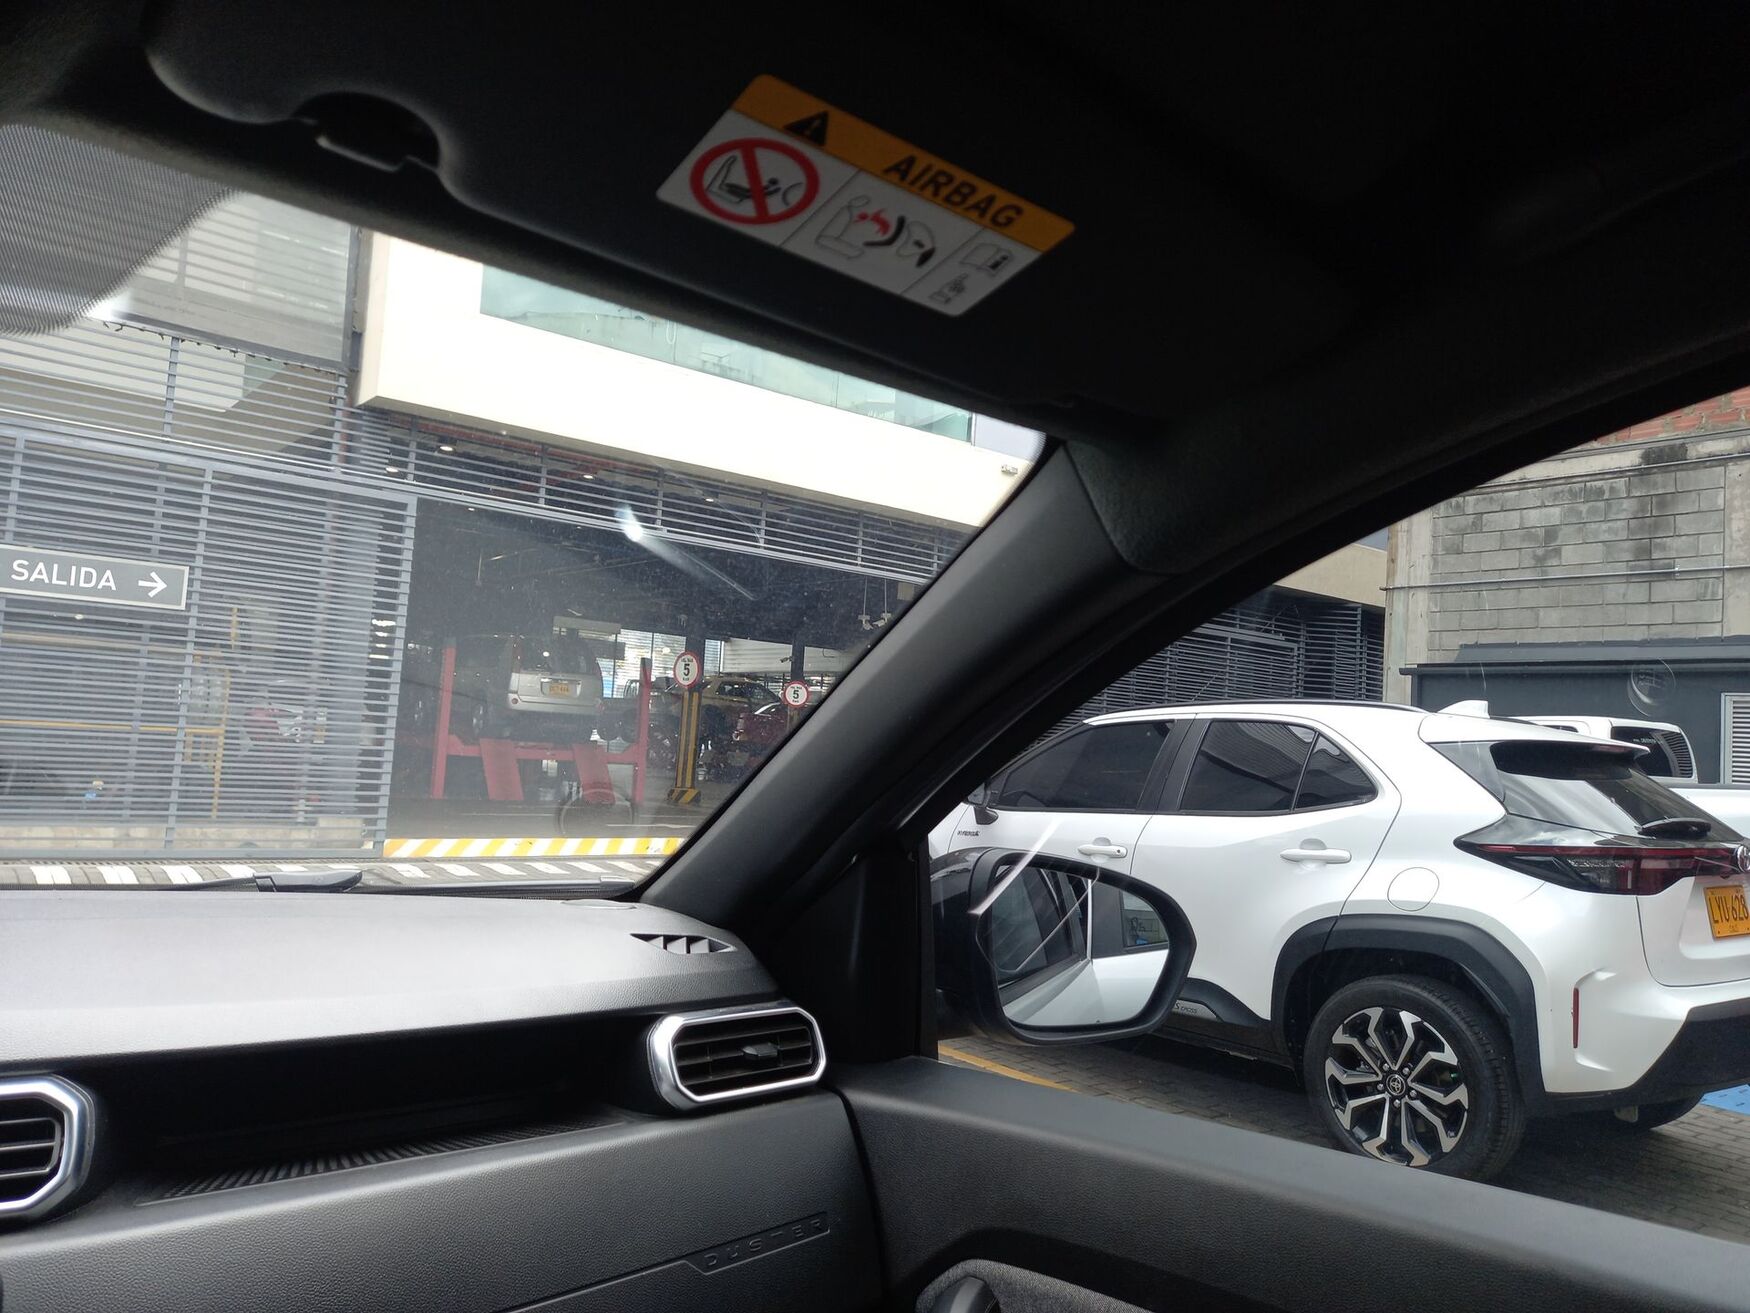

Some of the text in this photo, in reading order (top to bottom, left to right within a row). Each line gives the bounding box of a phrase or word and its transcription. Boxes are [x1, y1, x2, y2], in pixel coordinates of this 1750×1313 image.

[884, 155, 1024, 228] AIRBAG
[11, 559, 116, 590] SALIDA
[683, 663, 690, 677] 5
[792, 689, 799, 700] 5
[703, 1218, 821, 1266] DUSTER
